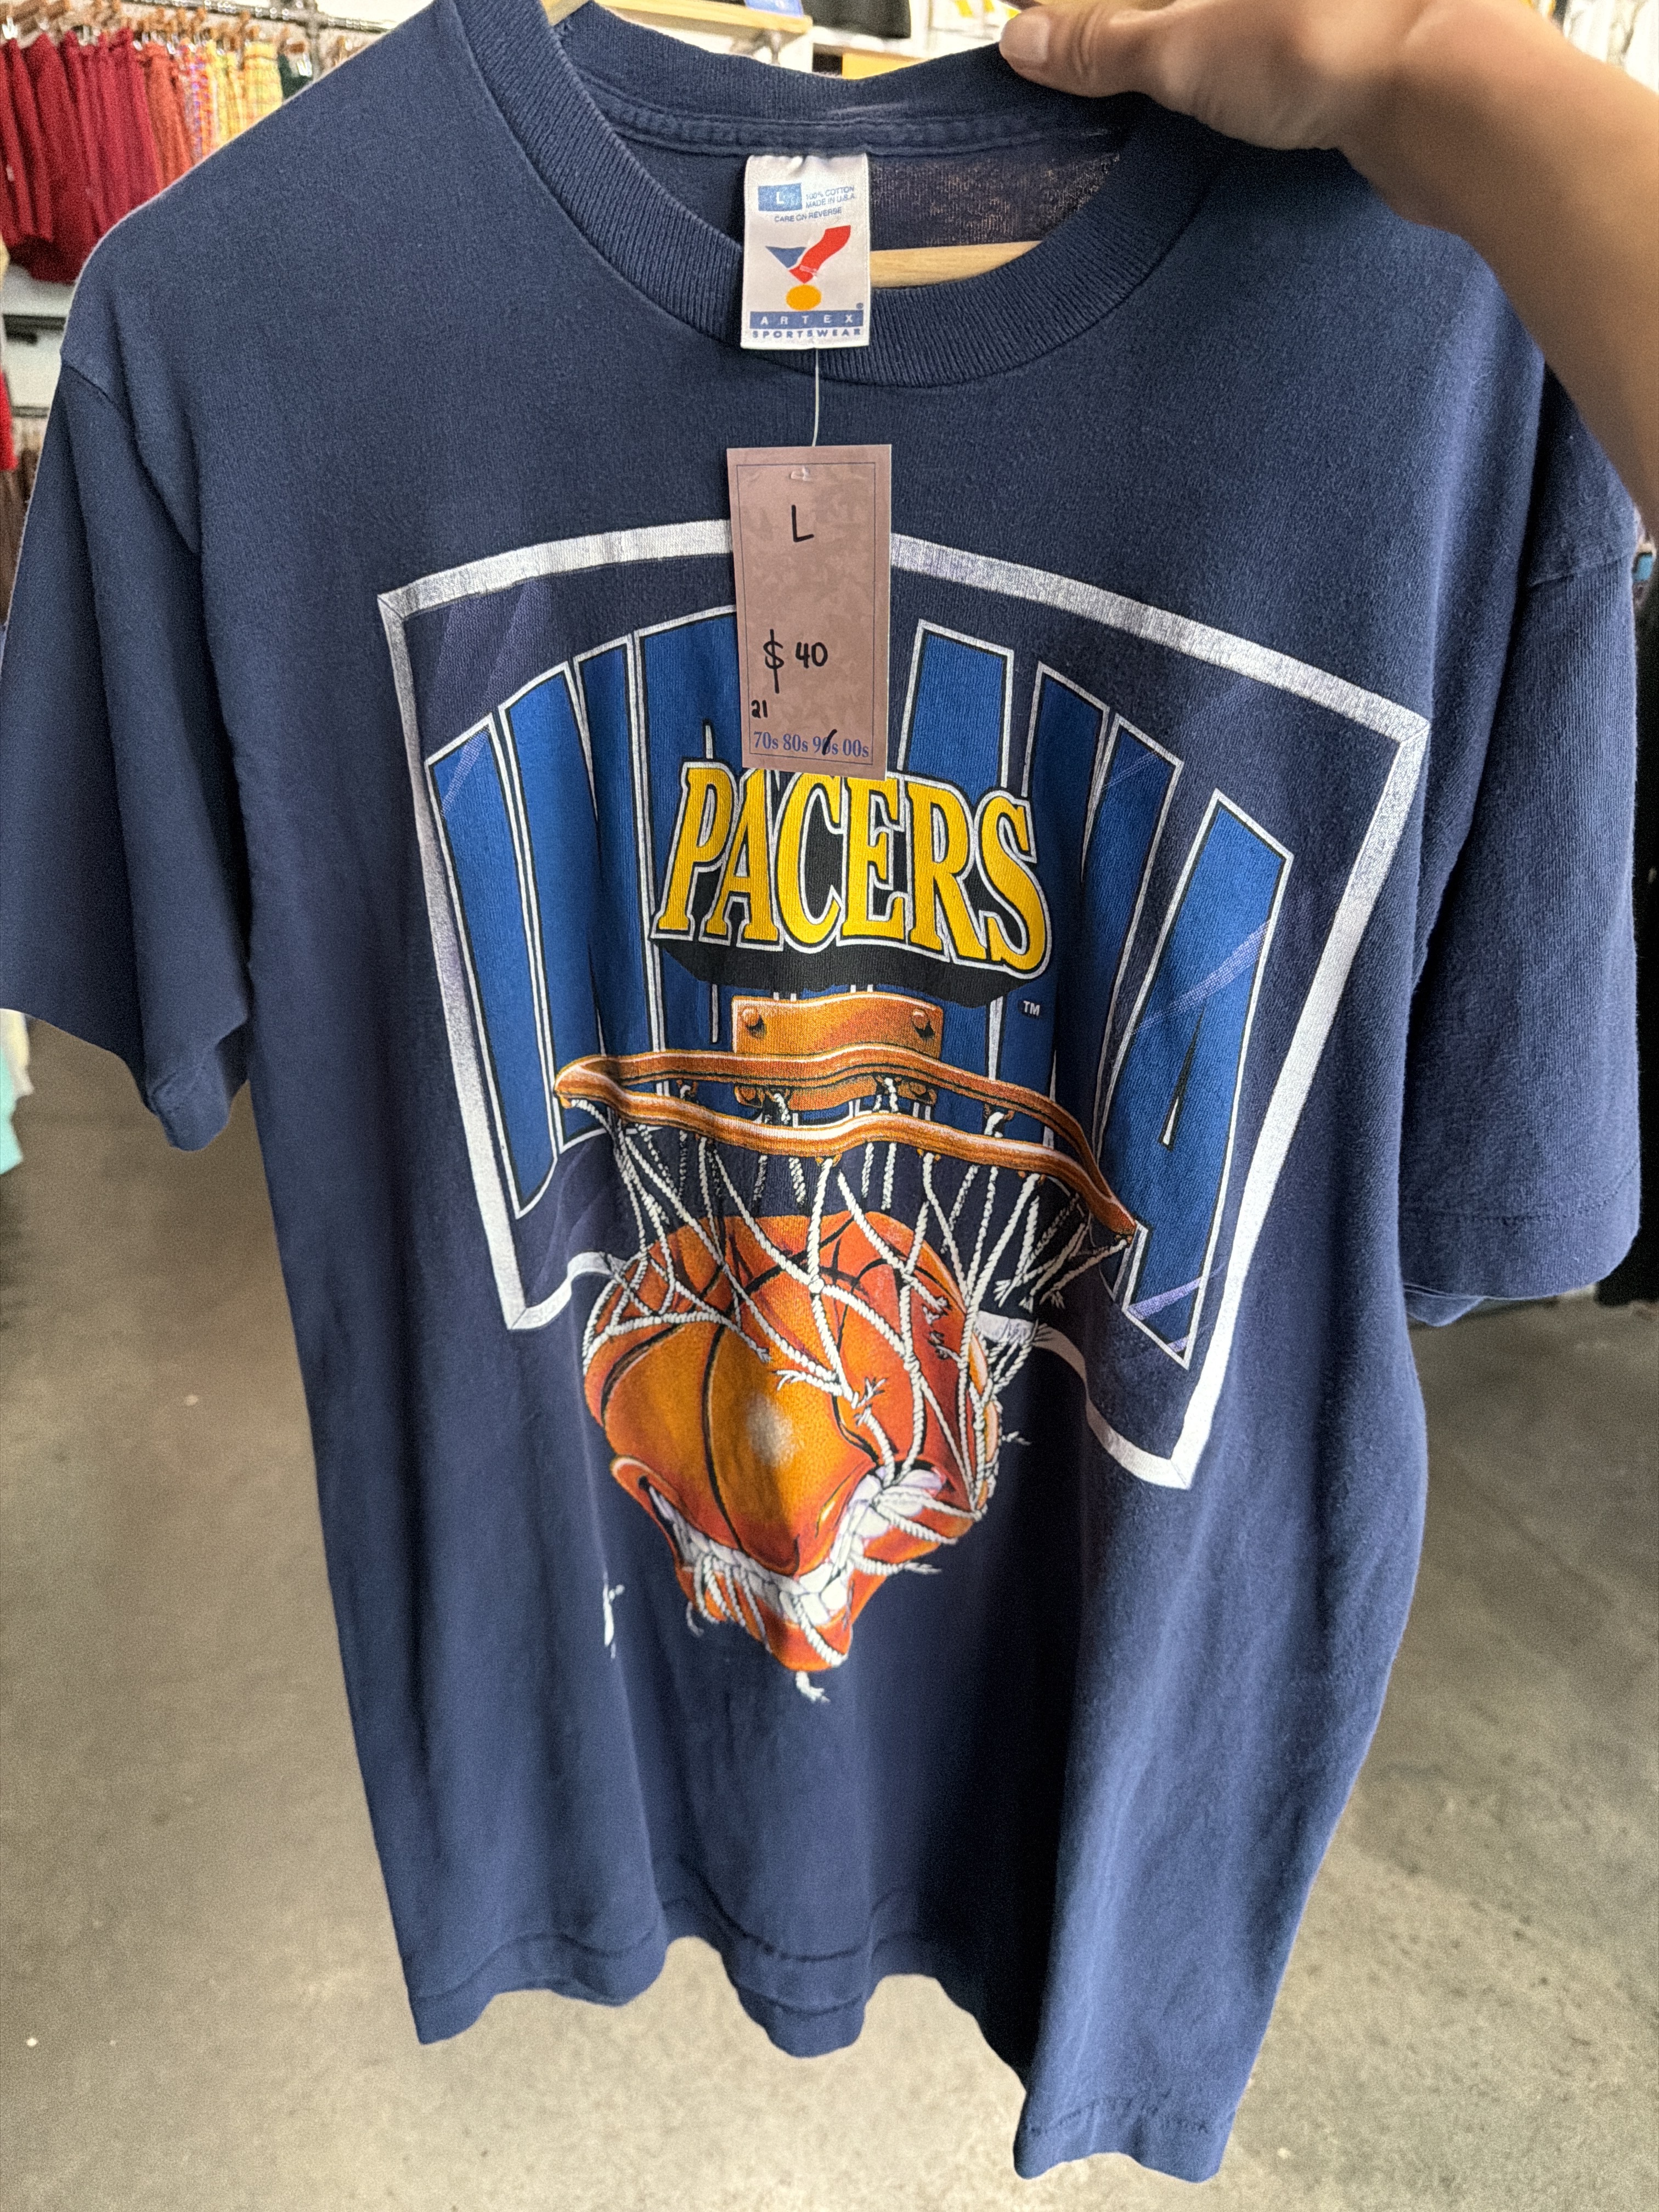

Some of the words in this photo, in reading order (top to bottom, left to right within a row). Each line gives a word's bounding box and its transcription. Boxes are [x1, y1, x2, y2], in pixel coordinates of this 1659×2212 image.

[776, 191, 785, 204] L
[805, 191, 824, 200] 100%
[825, 185, 855, 197] COTTON
[805, 198, 826, 208] MADE
[808, 206, 842, 219] REVERSE
[760, 314, 854, 325] ARTEX
[752, 328, 861, 338] SPORTSWEAR
[791, 505, 815, 543] L
[753, 731, 779, 750] 70s
[782, 733, 808, 752] 80s
[842, 738, 870, 758] 00s
[651, 761, 1052, 980] PACERS
[1023, 1000, 1041, 1017] TM
